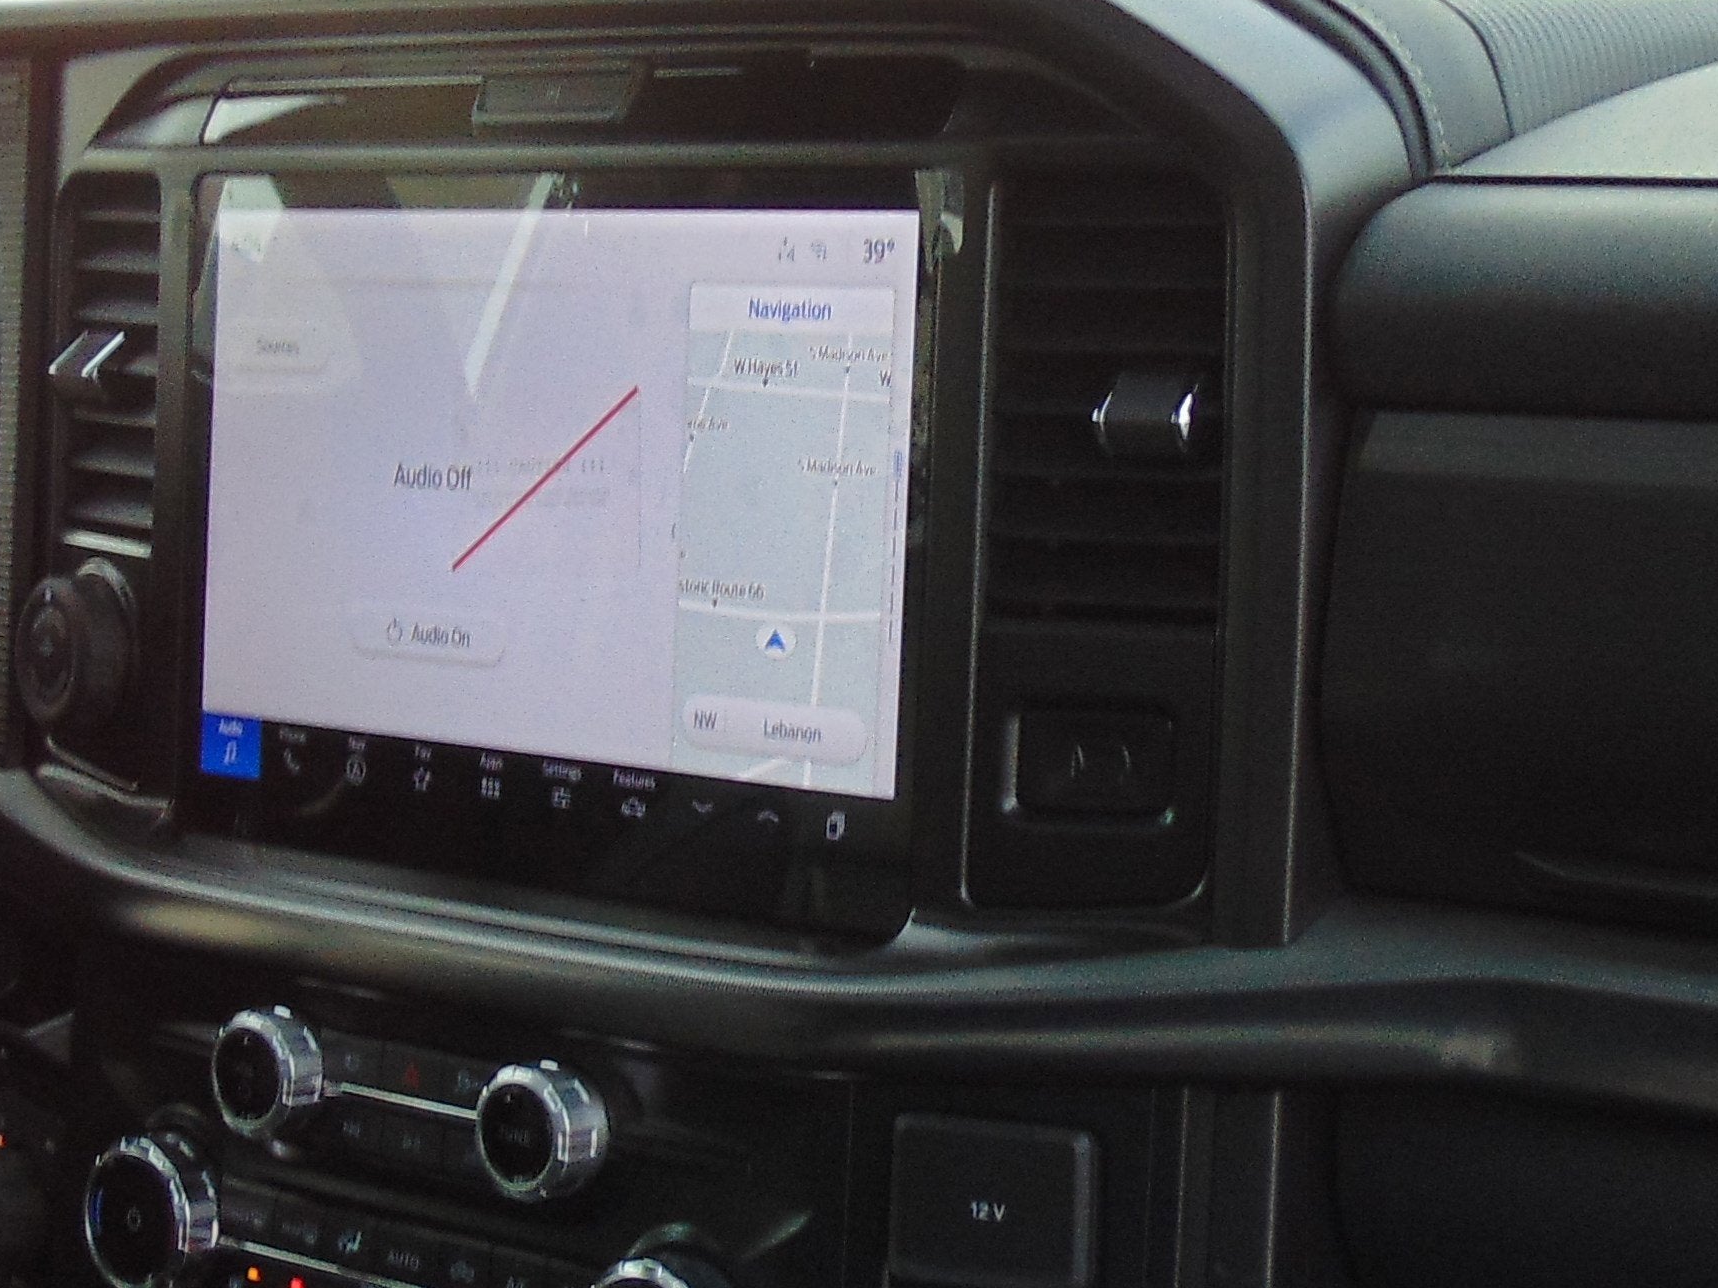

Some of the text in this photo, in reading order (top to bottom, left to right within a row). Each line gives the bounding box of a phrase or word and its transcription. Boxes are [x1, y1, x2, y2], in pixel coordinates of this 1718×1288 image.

[747, 295, 833, 323] Navigation
[393, 462, 472, 491] Audio Off
[410, 621, 471, 648] Audio On
[693, 709, 718, 730] NW
[763, 718, 823, 744] Lebanon
